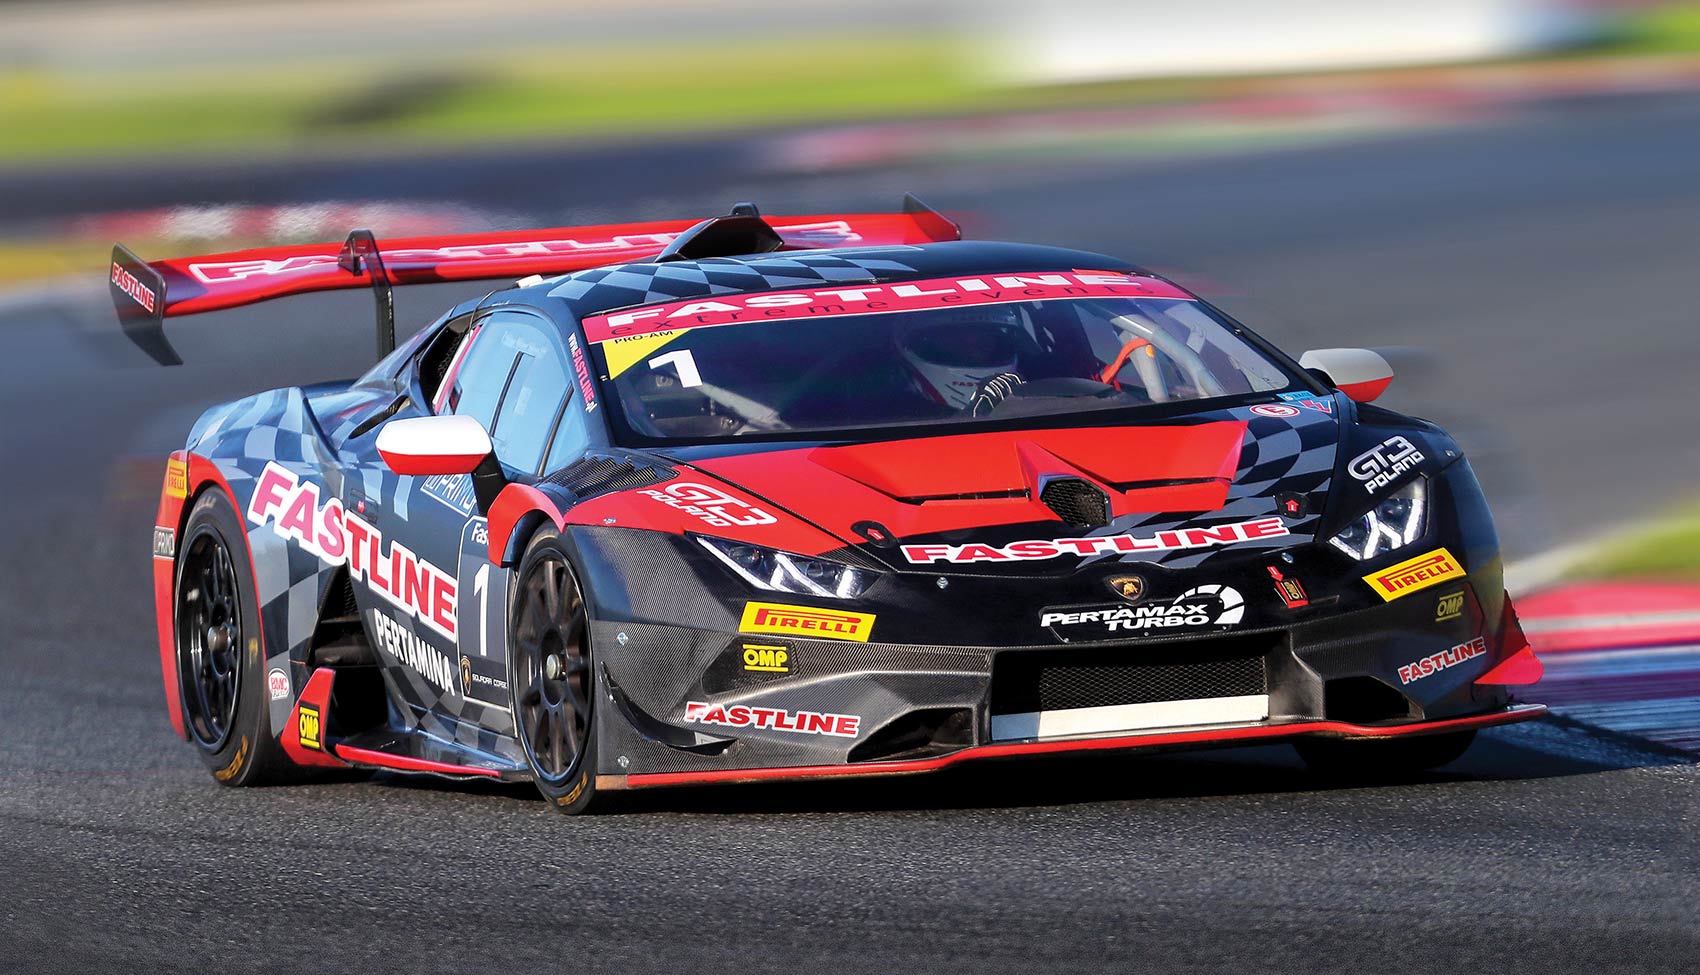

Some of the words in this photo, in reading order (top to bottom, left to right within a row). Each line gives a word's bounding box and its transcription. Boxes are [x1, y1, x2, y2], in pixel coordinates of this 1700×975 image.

[112, 262, 155, 313] FASTLINE
[607, 274, 1141, 327] FASTLINE
[611, 300, 889, 336] extreme
[941, 285, 1155, 303] events
[614, 329, 674, 344] PRO-AM
[648, 349, 703, 389] 1
[1347, 435, 1417, 481] GT3
[1364, 450, 1425, 494] POLAND
[636, 489, 732, 527] POLAND
[664, 482, 778, 527] GT3
[249, 462, 458, 641] FASTLINE
[901, 517, 1289, 563] FASTLINE
[1376, 554, 1454, 593] PIRELLI
[473, 563, 490, 657] 1
[753, 607, 862, 634] PIRELLI
[1041, 604, 1208, 628] PERTAMAX
[1104, 615, 1210, 631] TURBO
[1436, 595, 1464, 617] OMP
[373, 607, 456, 697] PERTAMINA
[743, 649, 788, 668] OMP
[1398, 636, 1487, 685] FASTLINE
[299, 713, 319, 742] OMP
[685, 702, 861, 738] FASTLINE
